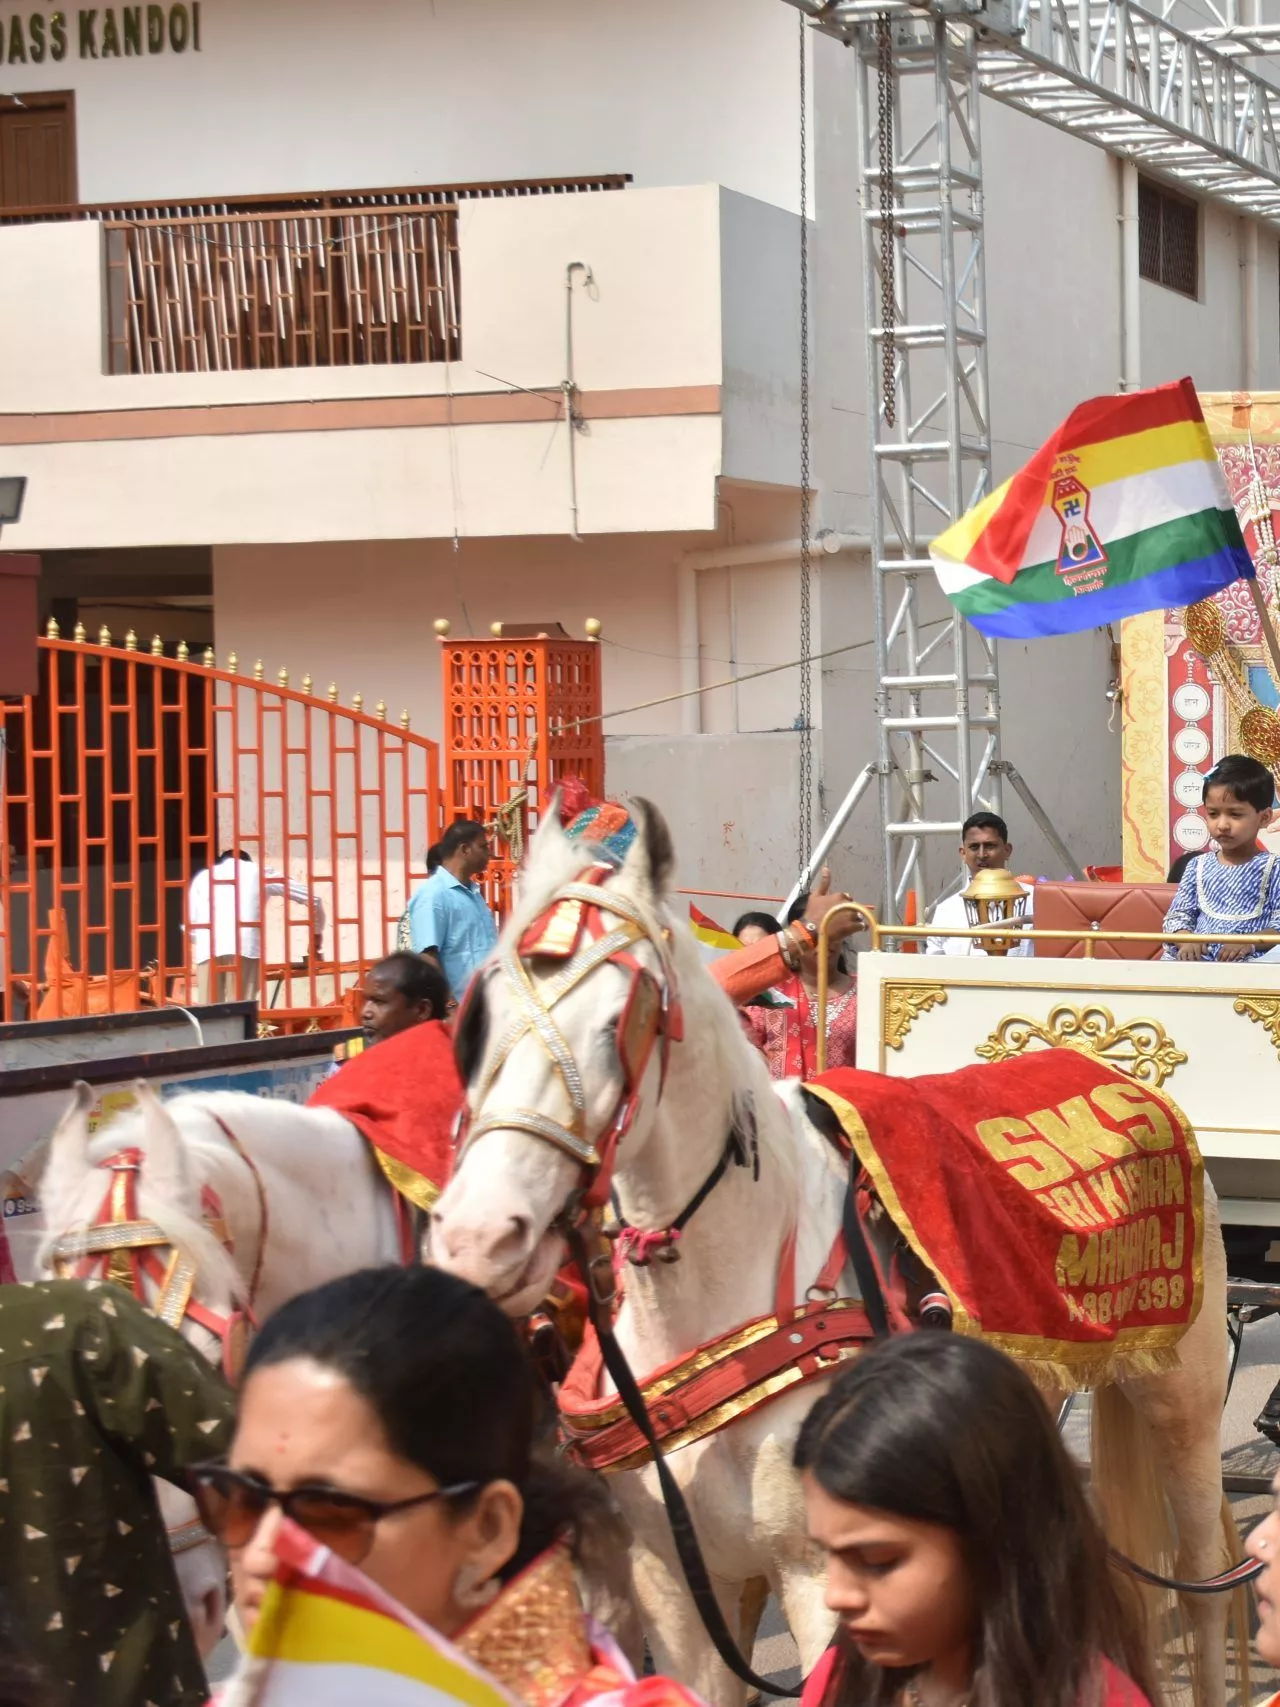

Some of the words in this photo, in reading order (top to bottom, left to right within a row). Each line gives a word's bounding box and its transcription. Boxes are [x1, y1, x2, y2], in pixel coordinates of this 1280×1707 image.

[0, 11, 67, 65] ASS
[78, 1, 202, 60] KANDOI
[974, 1082, 1175, 1191] SKS
